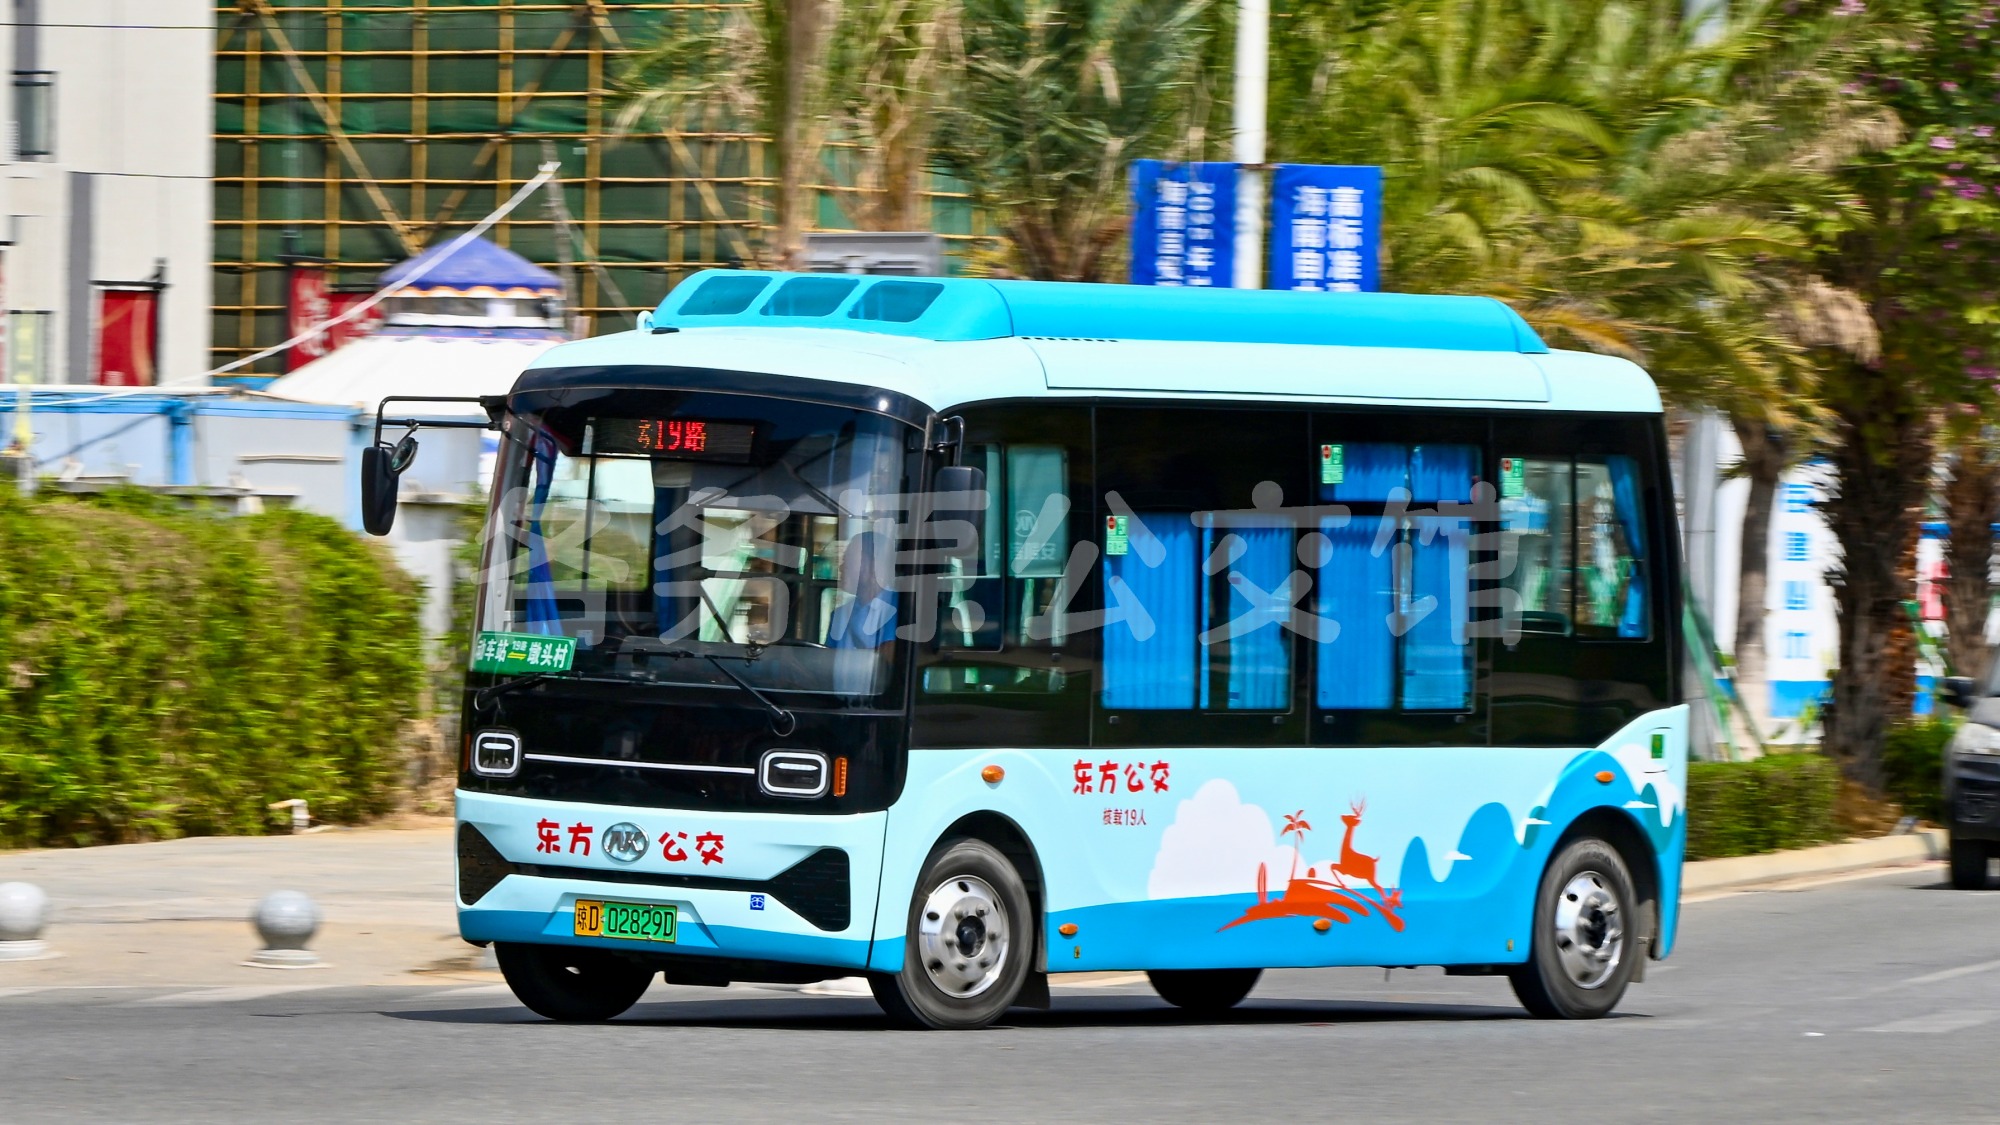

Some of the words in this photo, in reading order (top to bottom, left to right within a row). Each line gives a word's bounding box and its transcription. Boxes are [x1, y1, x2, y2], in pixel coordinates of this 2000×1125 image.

[1072, 759, 1170, 795] 东方公交
[536, 818, 593, 856] 东方
[658, 830, 725, 866] 公交
